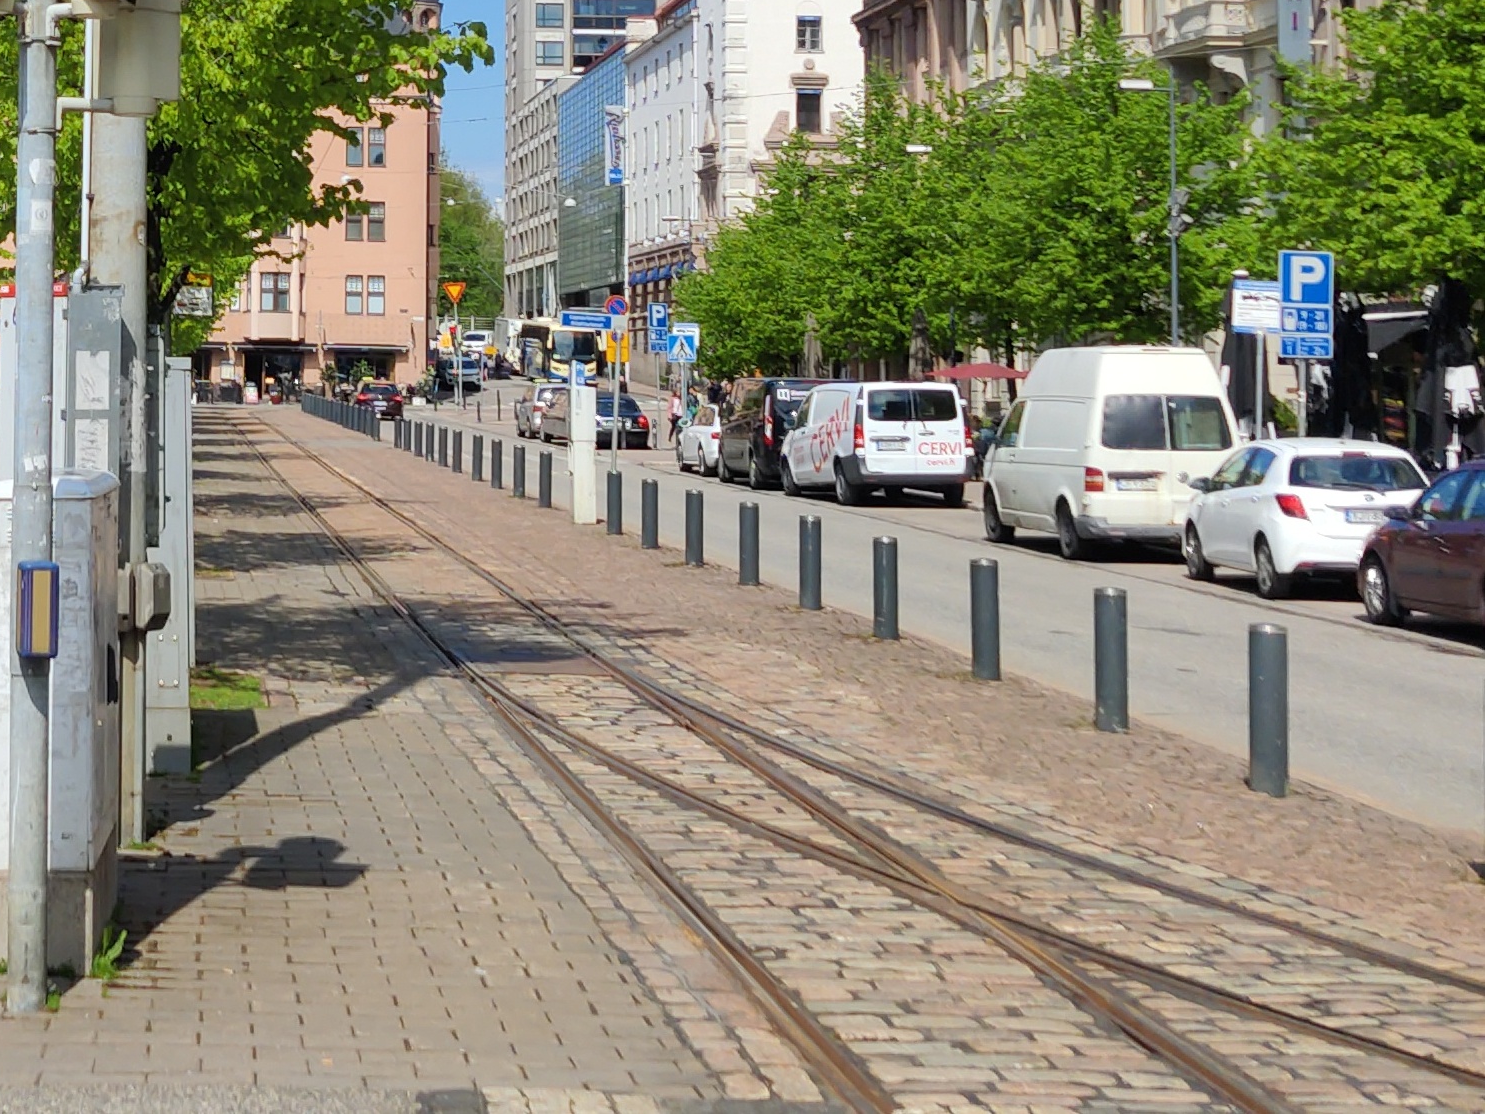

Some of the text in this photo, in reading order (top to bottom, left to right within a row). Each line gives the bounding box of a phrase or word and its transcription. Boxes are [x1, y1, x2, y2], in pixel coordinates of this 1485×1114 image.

[1289, 255, 1326, 302] P
[651, 304, 666, 327] P
[810, 396, 850, 473] CERVI
[918, 441, 962, 456] CERVI
